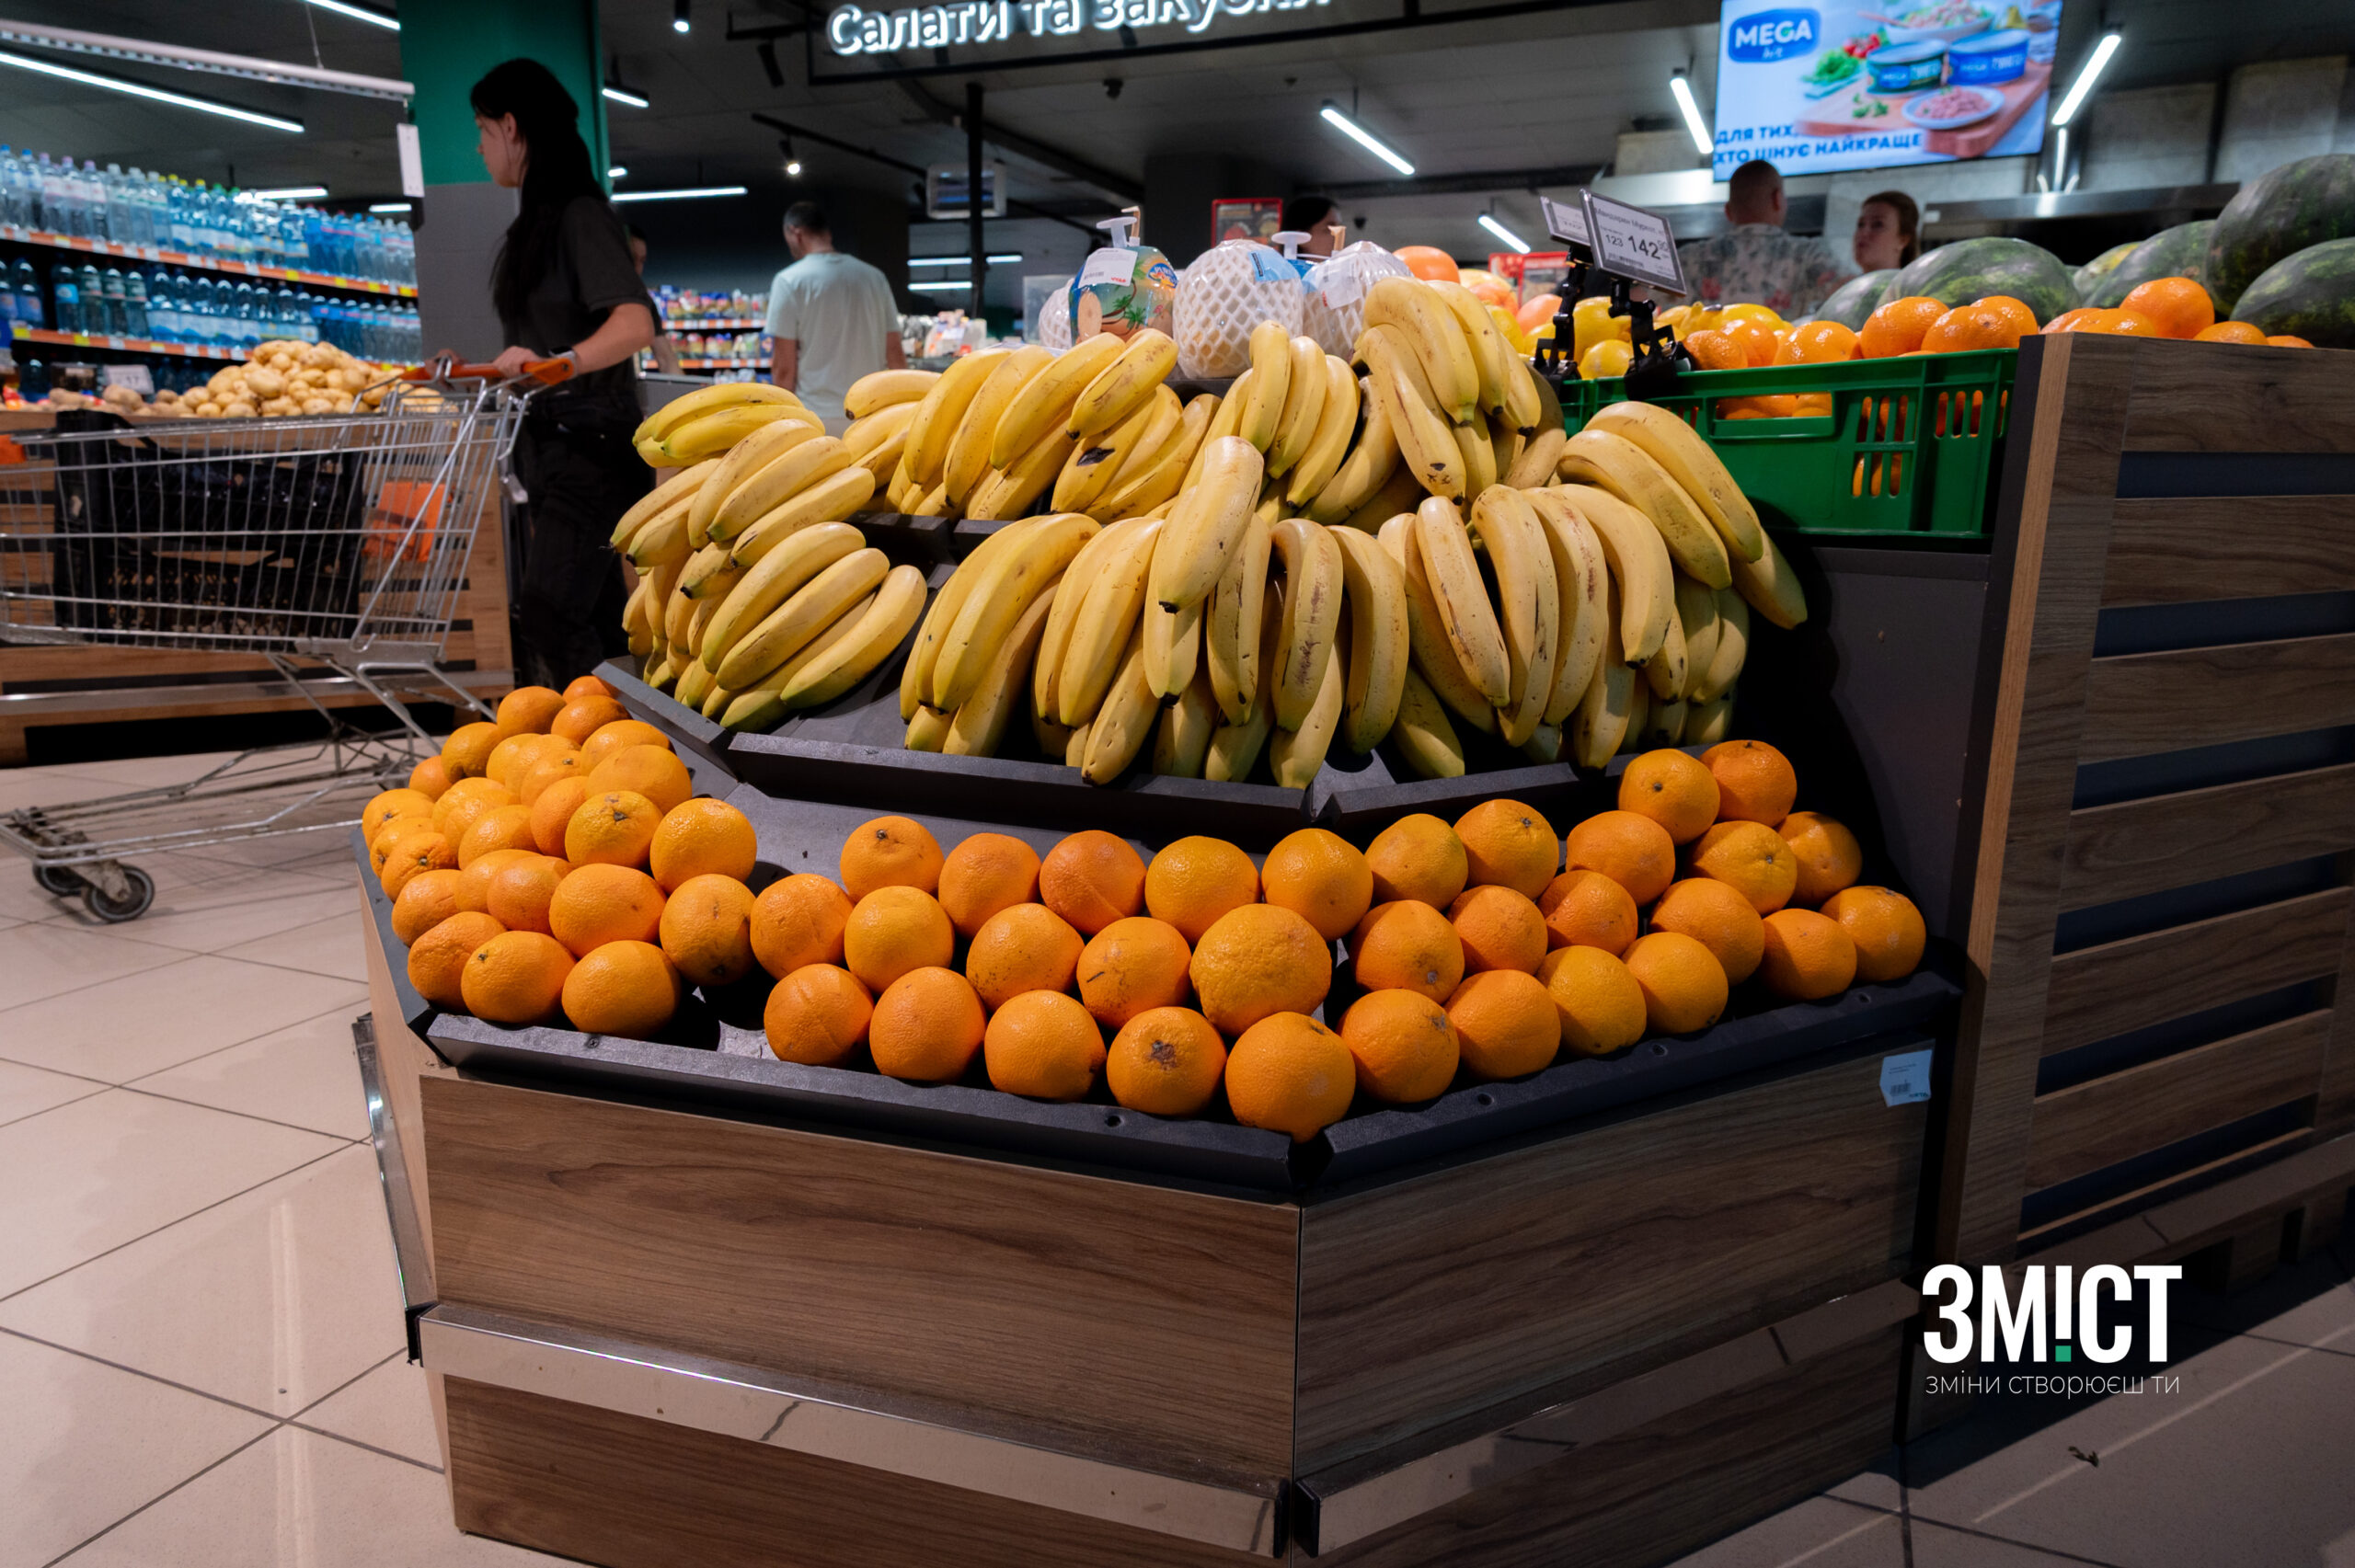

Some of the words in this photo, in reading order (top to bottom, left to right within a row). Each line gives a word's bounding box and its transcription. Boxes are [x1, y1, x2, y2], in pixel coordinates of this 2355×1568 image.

[829, 0, 1010, 55] Салати
[1020, 0, 1081, 35] та
[1093, 0, 1332, 32] заку
[1734, 17, 1812, 49] MEGA
[1713, 150, 1749, 165] ХТО
[1815, 133, 1923, 155] НАЙКРАЩЕ
[1715, 129, 1753, 144] ДЛЯ
[1605, 234, 1625, 247] 123
[1627, 235, 1661, 260] 142
